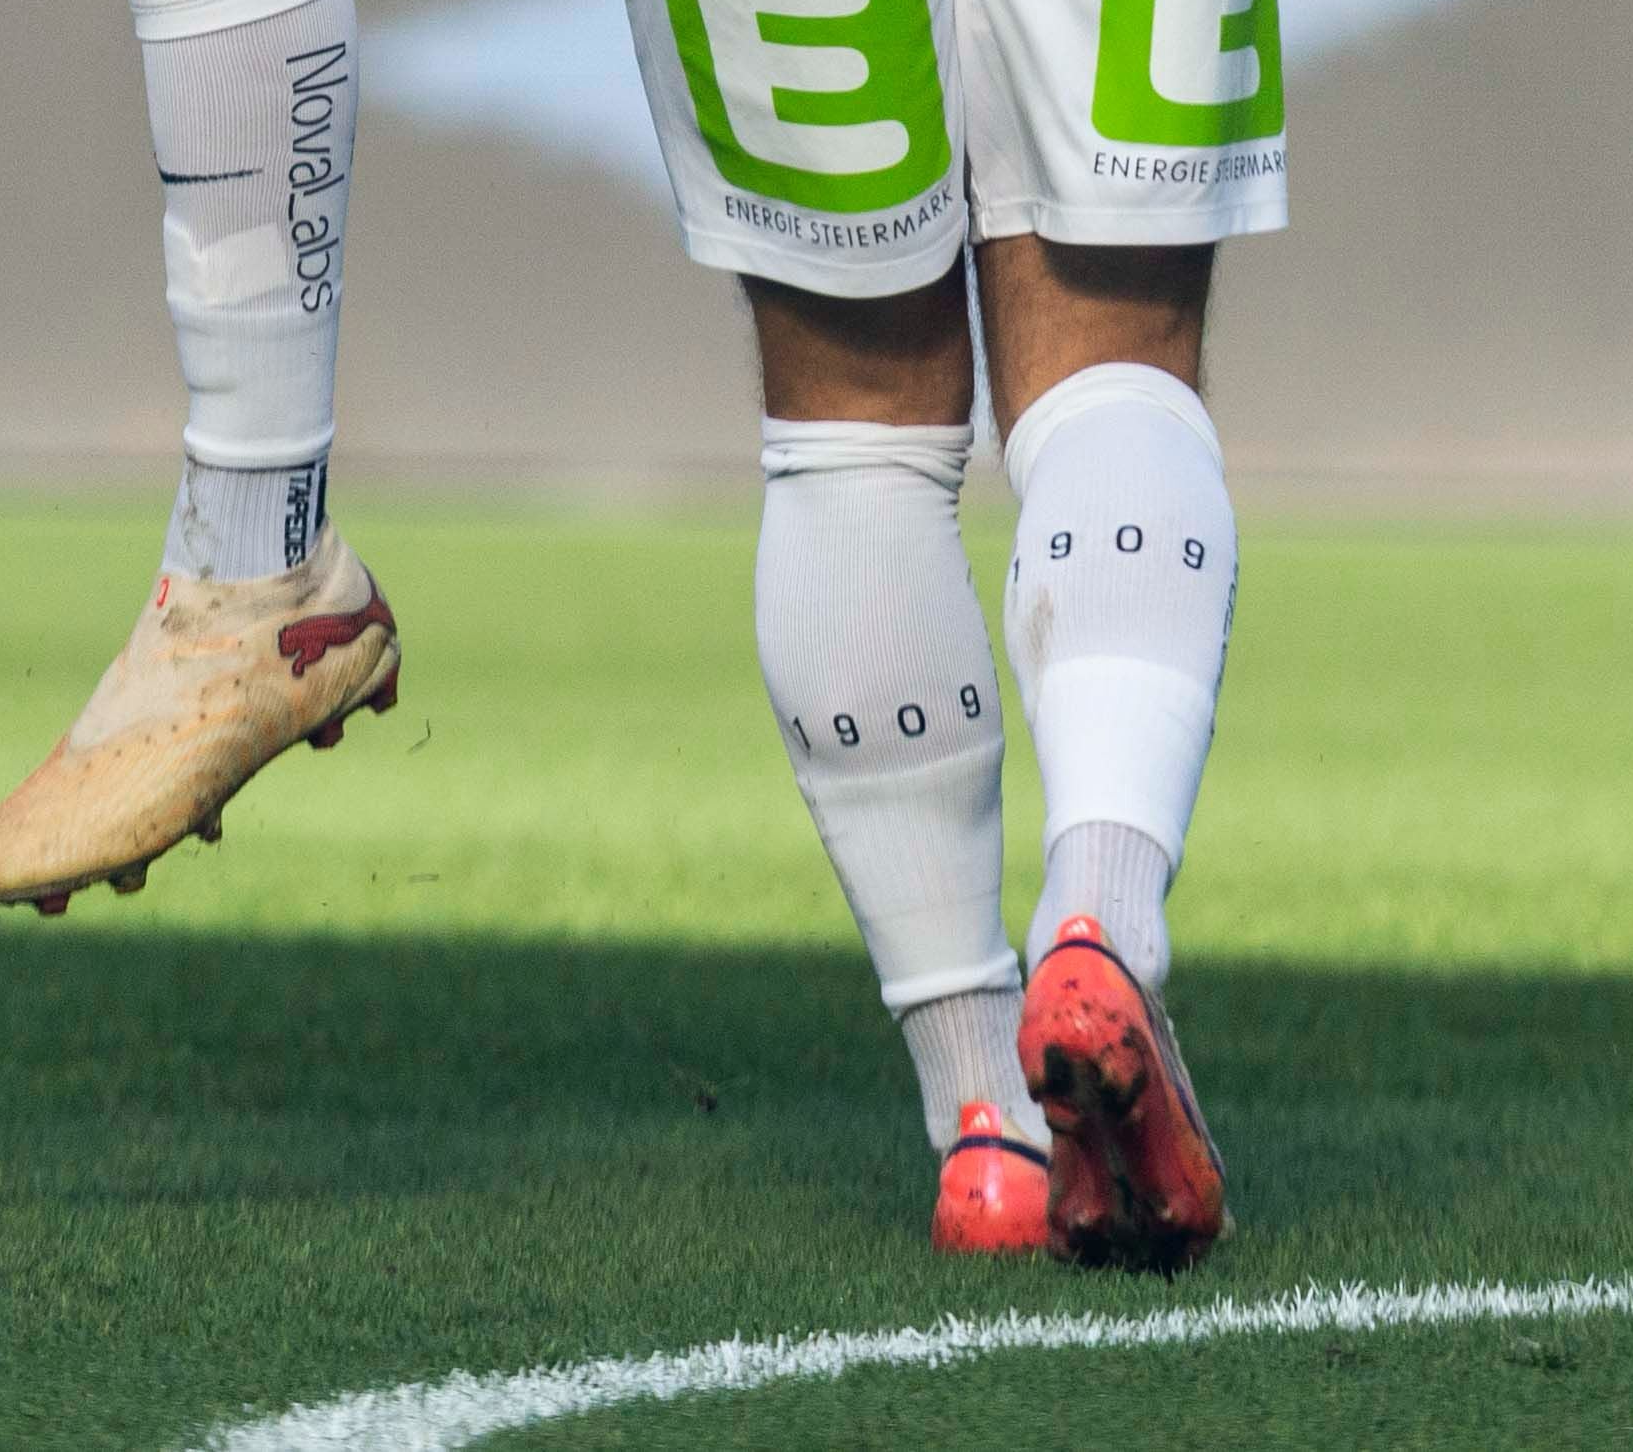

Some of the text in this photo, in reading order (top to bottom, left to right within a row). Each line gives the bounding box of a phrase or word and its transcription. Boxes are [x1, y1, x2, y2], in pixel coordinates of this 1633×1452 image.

[1093, 151, 1209, 184] ENERGIE
[724, 184, 953, 248] ENERGIE STEIERMARK
[1013, 523, 1206, 583] 1909
[792, 682, 981, 752] 1909
